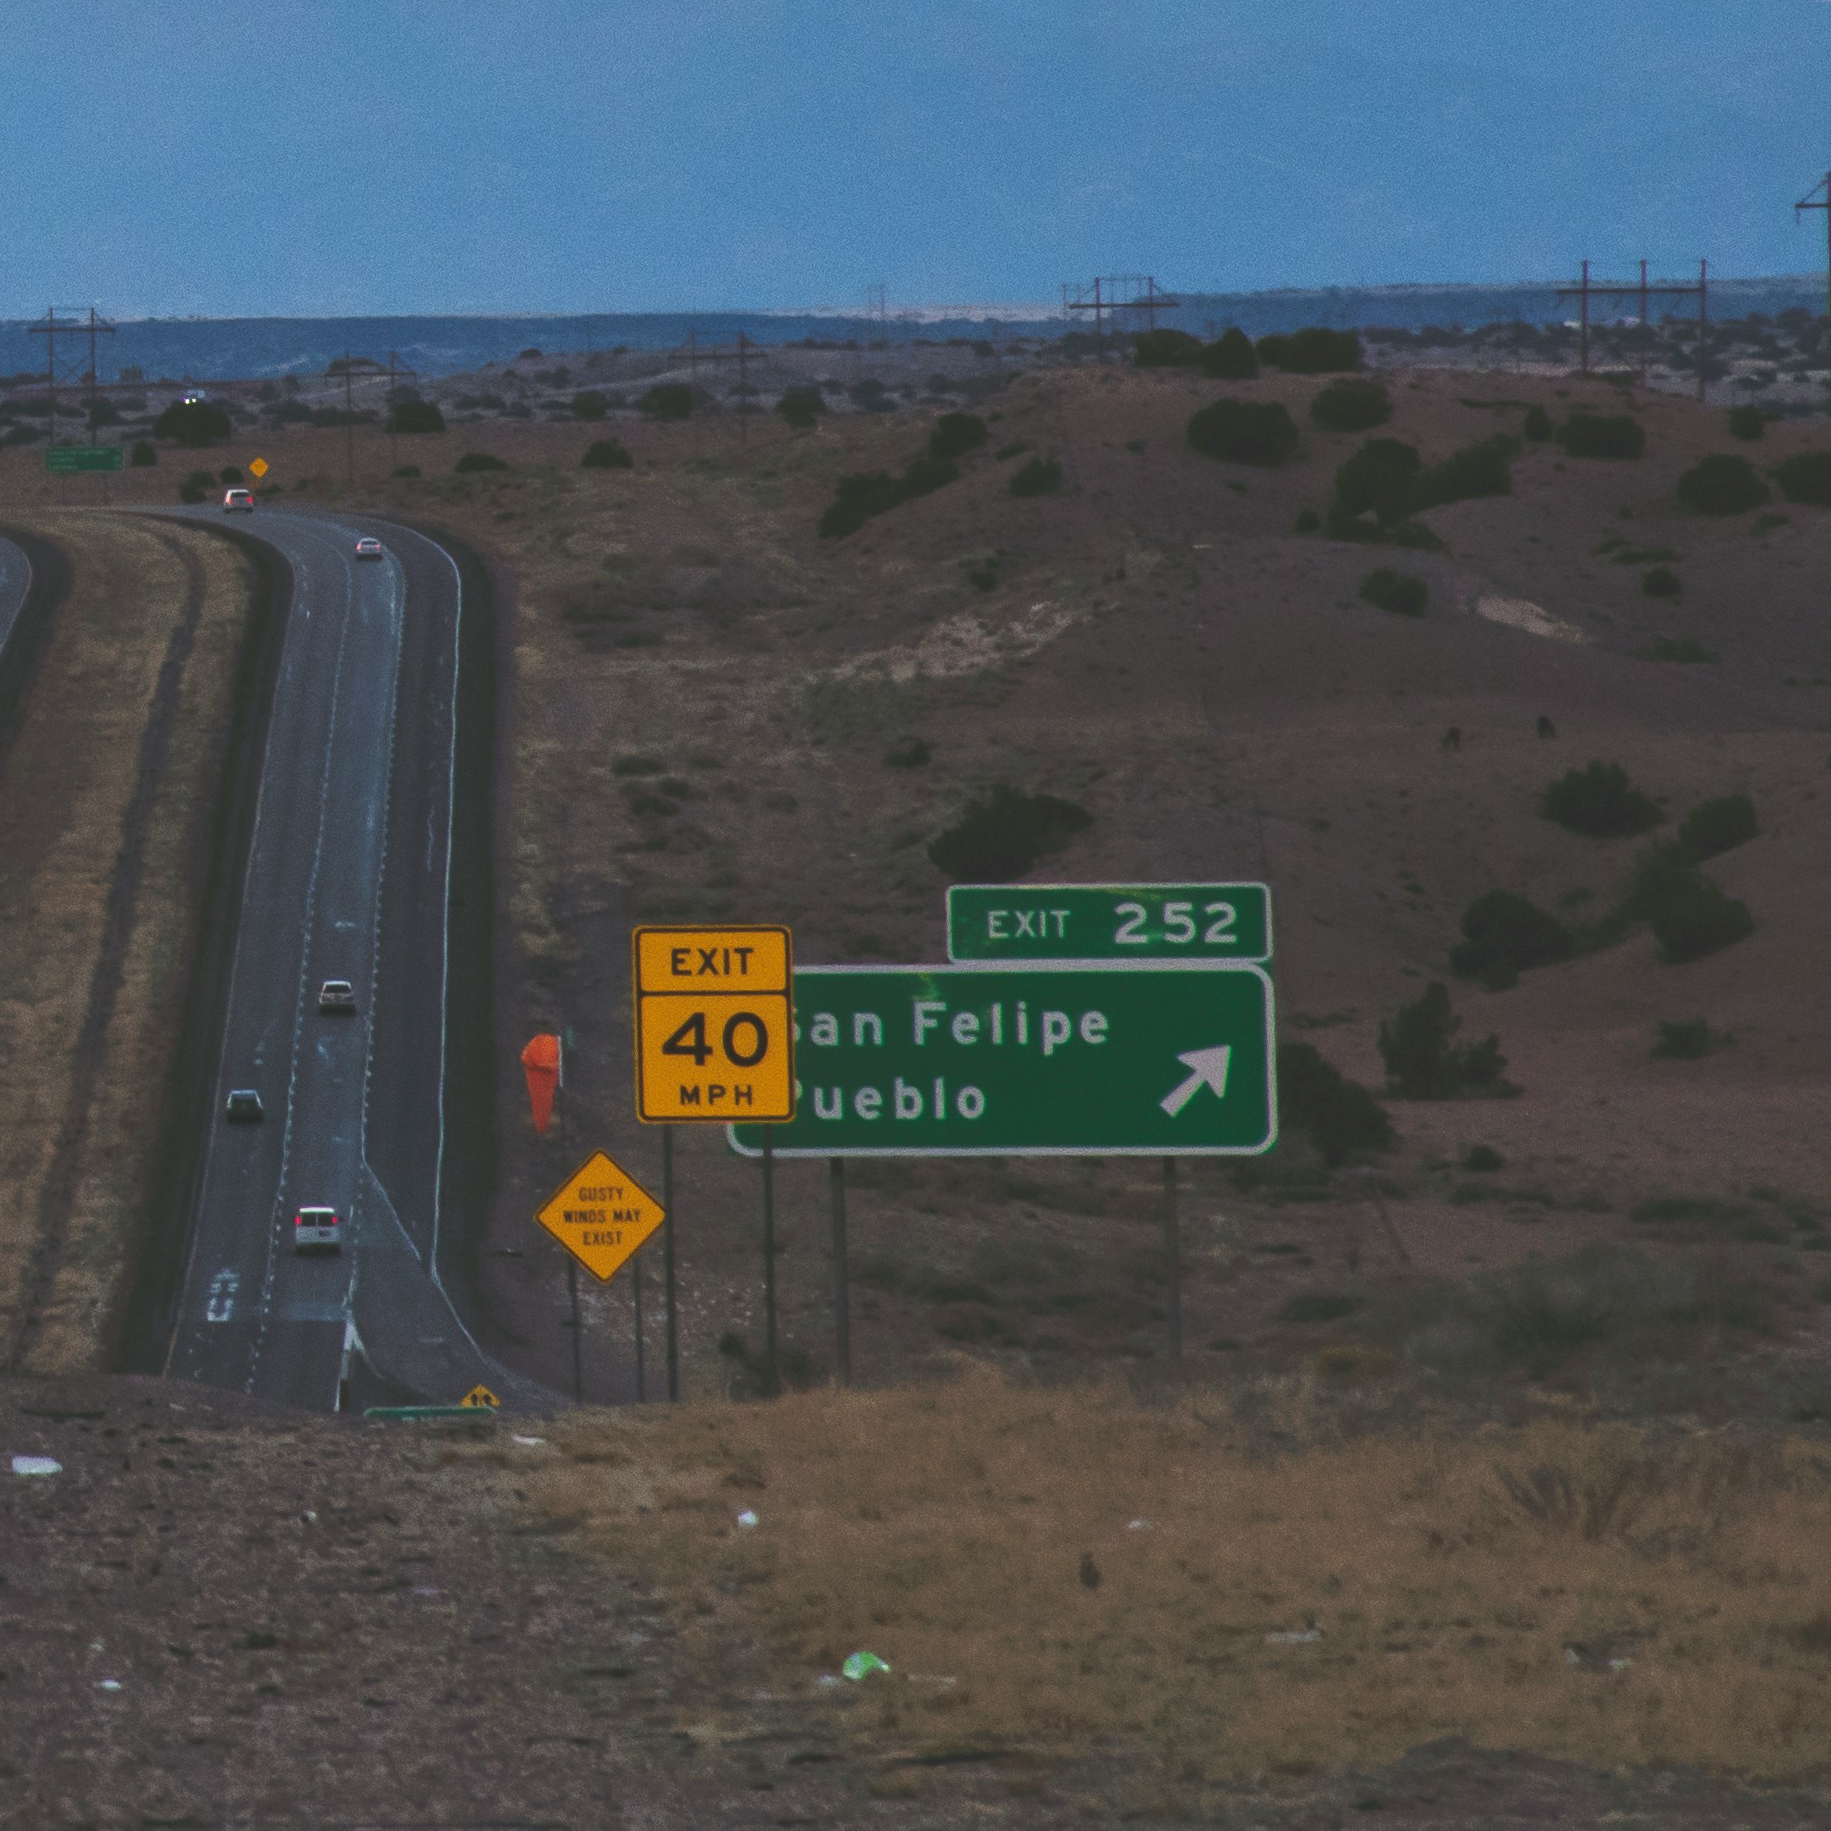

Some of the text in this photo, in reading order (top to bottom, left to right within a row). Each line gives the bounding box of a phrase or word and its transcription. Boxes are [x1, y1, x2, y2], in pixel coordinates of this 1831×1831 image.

[988, 902, 1238, 944] EXIT 252
[671, 947, 754, 976] EXIT
[662, 1012, 768, 1067] 40
[793, 1001, 1108, 1056] an Felipe
[679, 1084, 753, 1105] MPH
[794, 1077, 986, 1120] ueblo
[579, 1187, 623, 1201] GUSTY
[563, 1209, 640, 1223] WINDS MAY
[583, 1231, 622, 1246] EXIST
